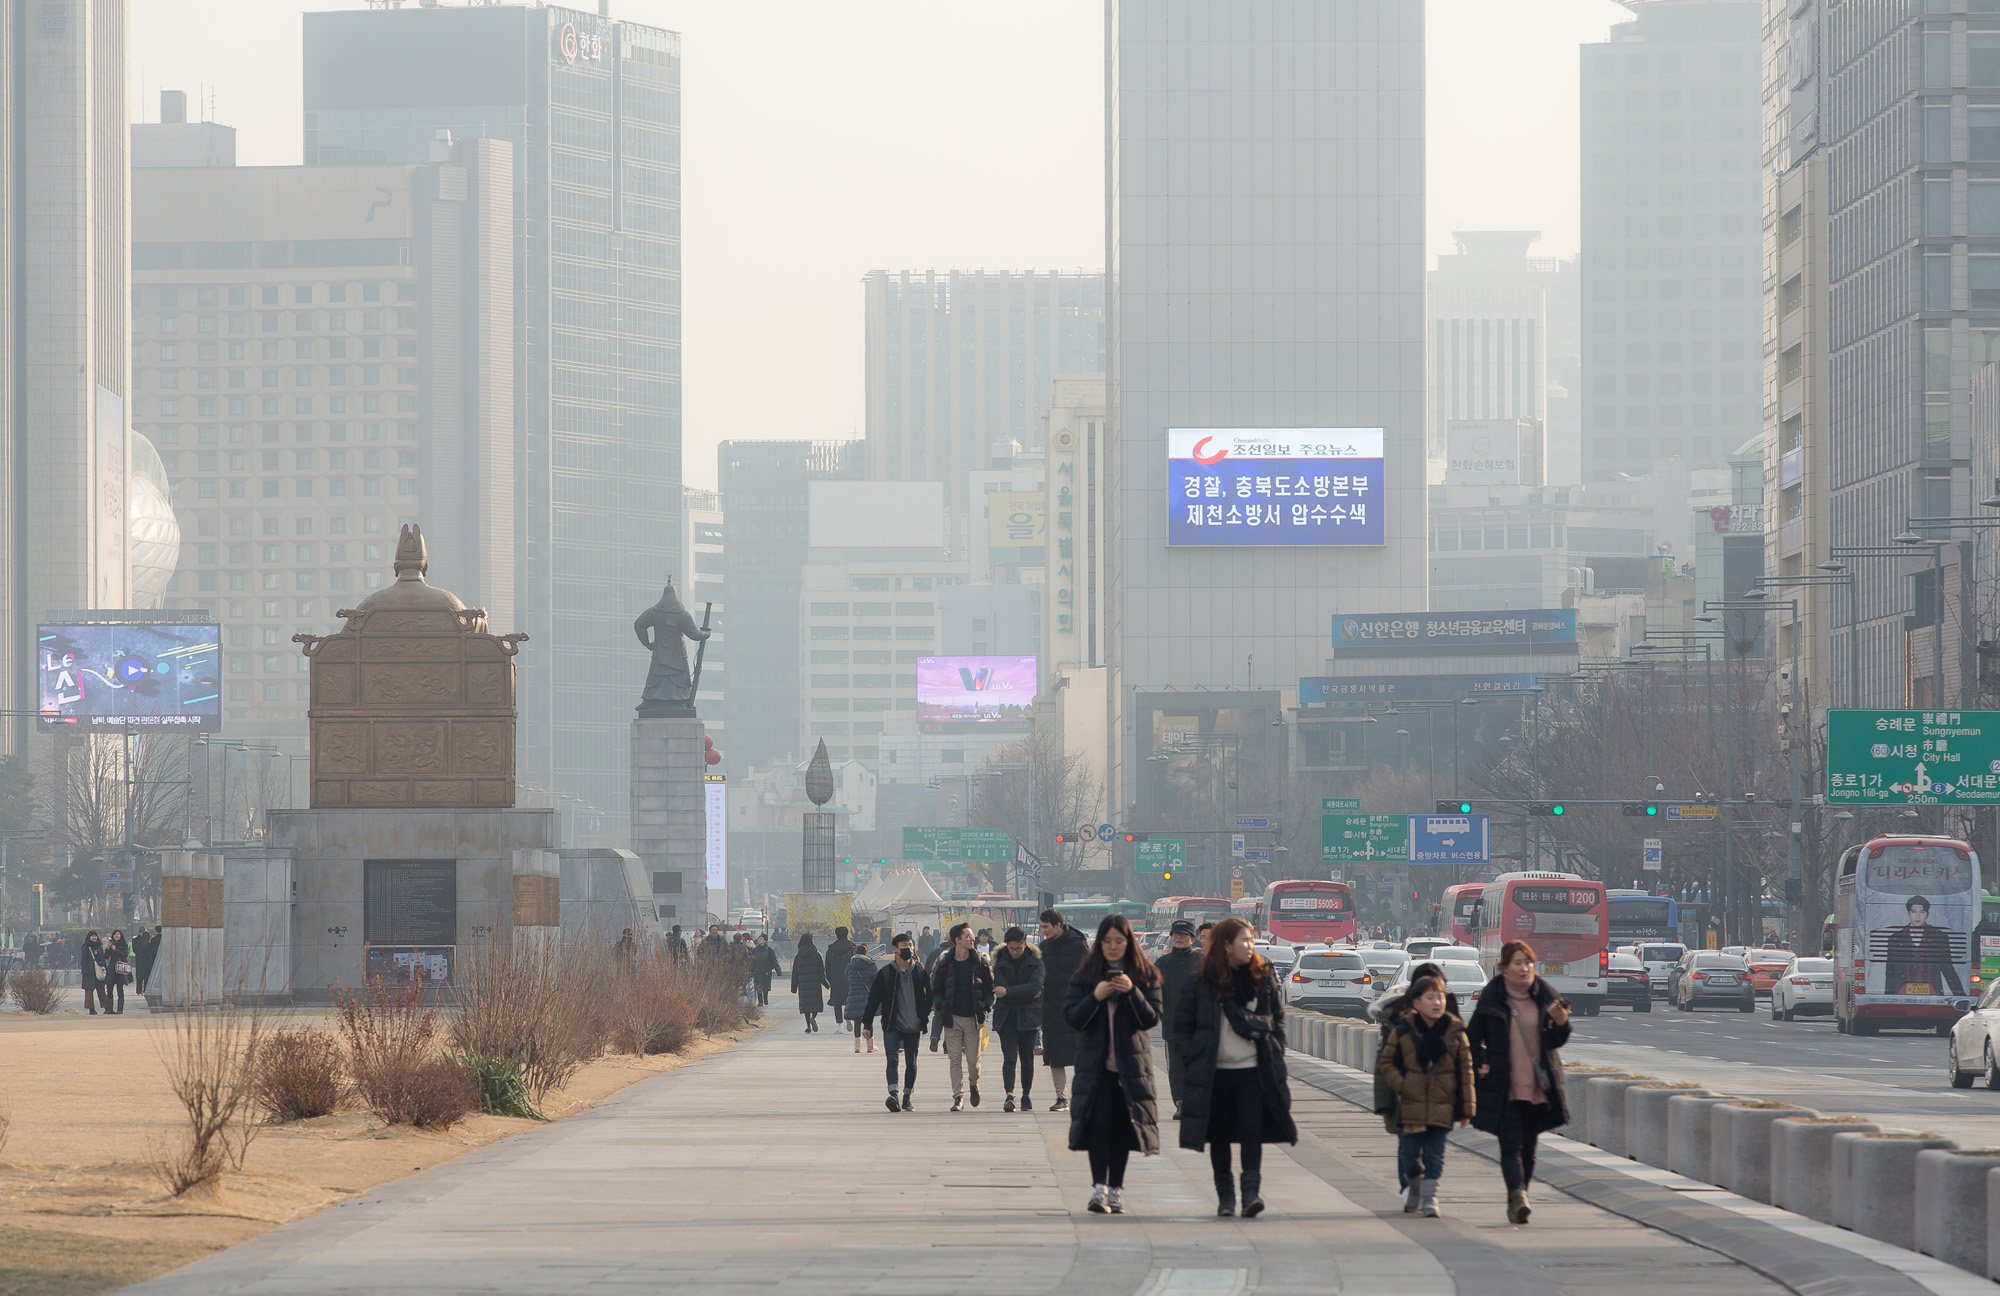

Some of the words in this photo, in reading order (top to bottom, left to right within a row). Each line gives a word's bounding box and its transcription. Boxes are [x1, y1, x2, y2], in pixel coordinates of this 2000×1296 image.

[580, 31, 602, 62] 한화
[1233, 444, 1291, 455] 조선일보
[1299, 445, 1357, 455] 주요뉴스
[1452, 460, 1514, 471] 한화손해보험
[1185, 476, 1227, 498] 경찰,
[1236, 476, 1368, 497] 충북도소방본부
[1187, 504, 1281, 525] 제천소방서
[1292, 504, 1366, 525] 압수수색
[1058, 462, 1073, 633] 서울특별시의회
[1360, 621, 1419, 639] 신한은행
[1426, 619, 1526, 637] 청소년금융교육센터
[1322, 685, 1395, 694] 한국금융사박물관
[188, 717, 201, 725] 시작
[1875, 718, 1916, 731] 숭례문
[1923, 727, 1981, 737] Sungnyemun
[1876, 746, 1886, 755] 60
[1890, 745, 1917, 758] 시청
[1923, 753, 1940, 764] City
[1944, 753, 1960, 762] Hall
[1831, 774, 1882, 787] 종로1가
[1956, 774, 2000, 789] 서대문
[1831, 788, 1860, 798] Jongno
[1908, 795, 1938, 804] 250m
[1318, 899, 1338, 908] 5500-2
[1570, 893, 1595, 903] 1200
